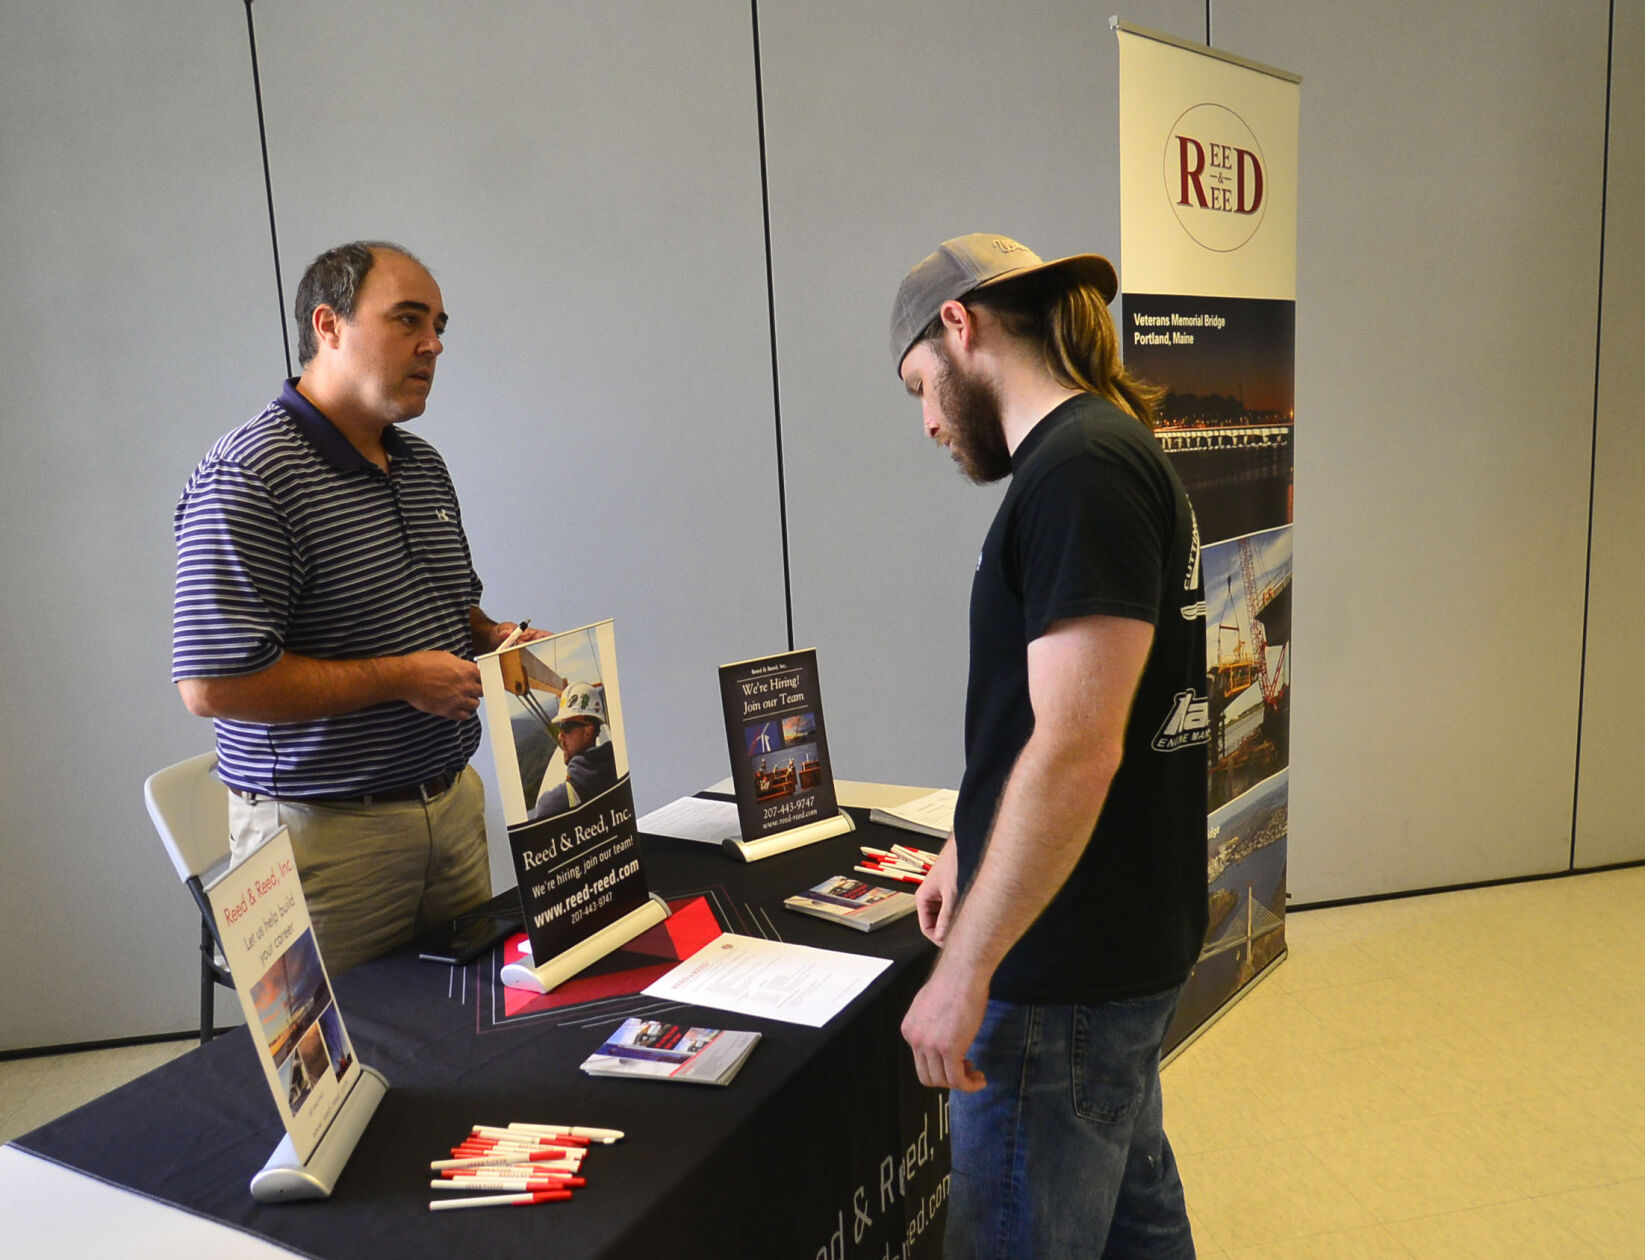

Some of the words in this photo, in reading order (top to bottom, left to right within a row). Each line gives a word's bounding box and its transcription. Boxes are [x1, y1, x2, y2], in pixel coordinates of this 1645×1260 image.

[1133, 313, 1170, 326] Veterans
[1171, 313, 1203, 326] Memorial
[1204, 314, 1225, 329] Bridge
[1134, 332, 1171, 346] Portland,
[1173, 332, 1194, 344] Maine
[742, 682, 768, 696] We're
[770, 674, 800, 690] Hiring!
[743, 700, 761, 715] Join
[762, 699, 778, 709] our
[778, 692, 805, 705] Team
[763, 795, 815, 820] 207-443-9747
[522, 839, 558, 871] Reed
[559, 833, 573, 852] &
[574, 815, 609, 845] Reed,
[610, 807, 632, 827] Inc.
[532, 878, 556, 899] We're
[583, 856, 599, 874] join
[599, 848, 612, 863] our
[612, 835, 634, 856] team!
[223, 893, 249, 928] Reed
[247, 888, 257, 906] &
[255, 867, 281, 898] Reed,
[533, 858, 641, 929] www.reed-reed.com
[571, 891, 614, 925] 207-443-9747
[243, 933, 255, 951] Let
[256, 926, 265, 940] us
[263, 911, 279, 932] help
[277, 892, 296, 918] build
[260, 944, 274, 968] your
[274, 922, 295, 948] career
[853, 1186, 873, 1245] &
